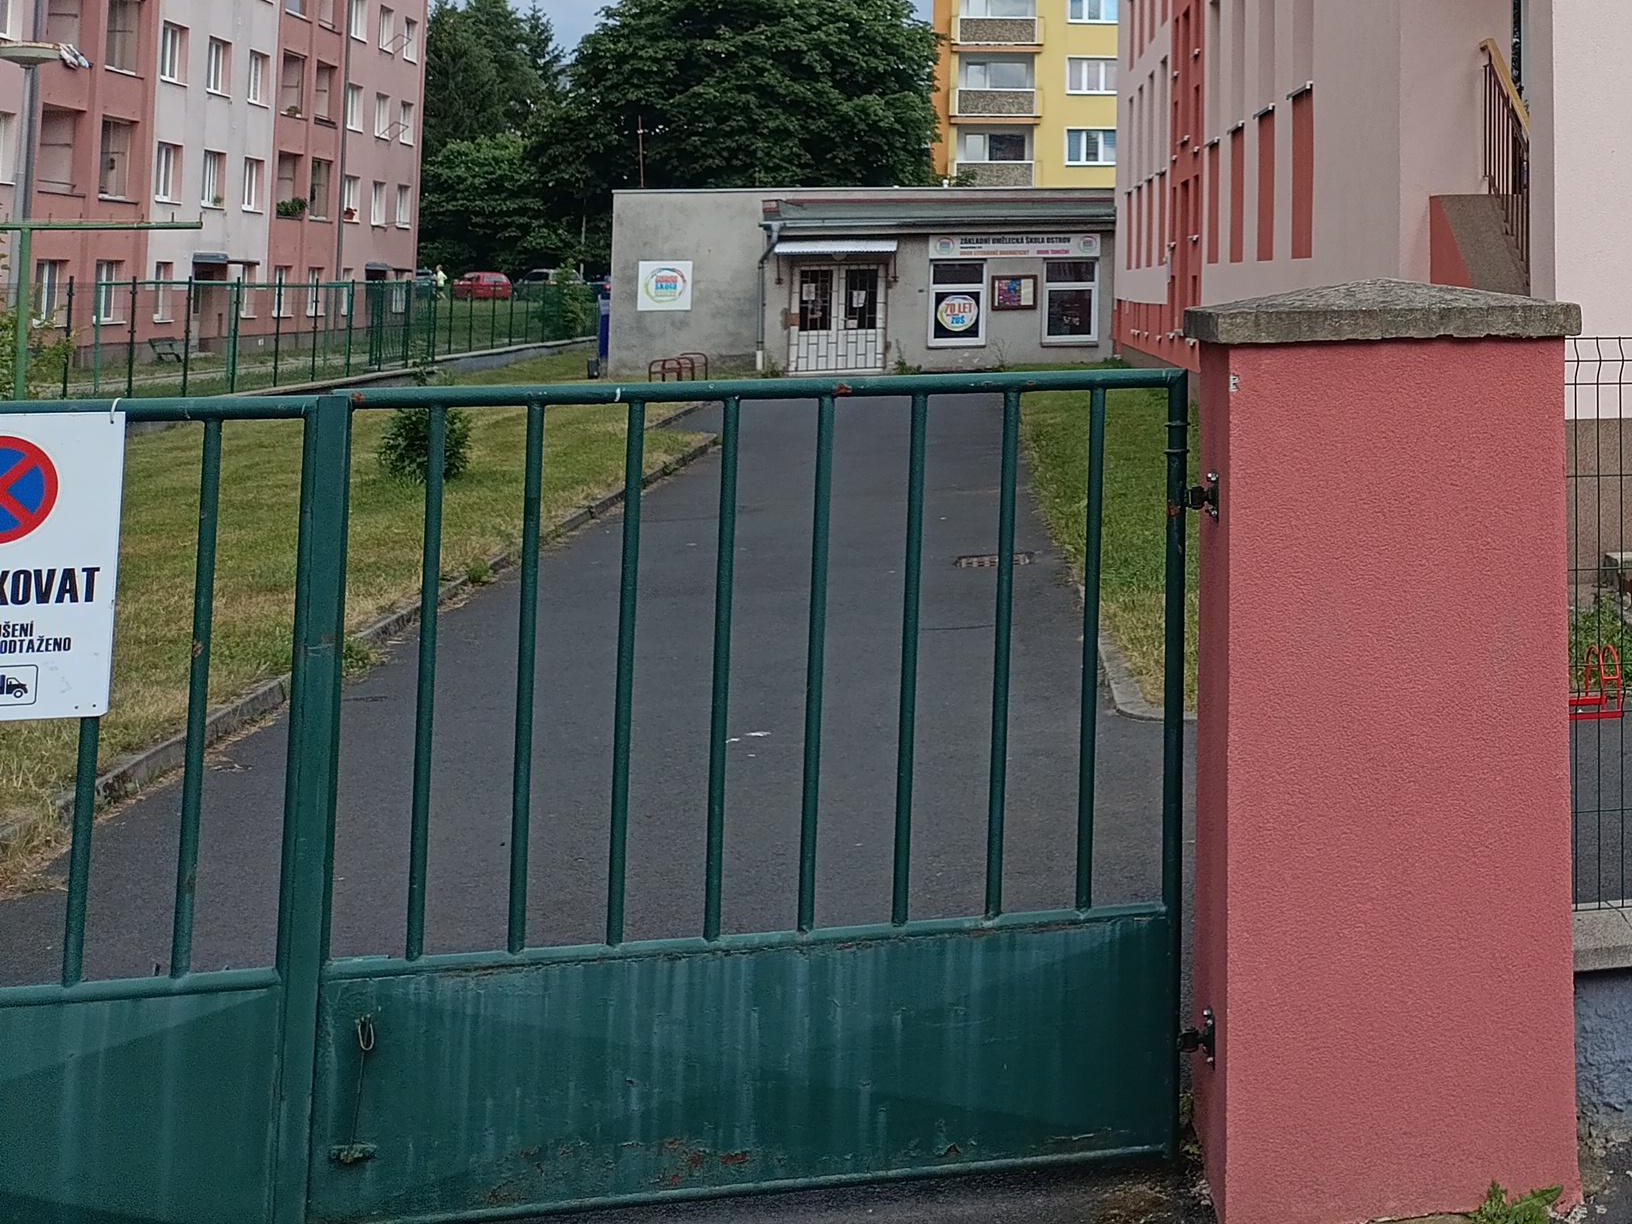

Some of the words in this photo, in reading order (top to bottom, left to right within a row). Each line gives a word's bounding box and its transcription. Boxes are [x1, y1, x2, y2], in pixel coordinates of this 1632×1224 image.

[944, 303, 955, 314] 70
[958, 302, 973, 314] LET
[0, 620, 34, 638] ŠENÍ
[0, 635, 72, 655] ODTAŽENO
